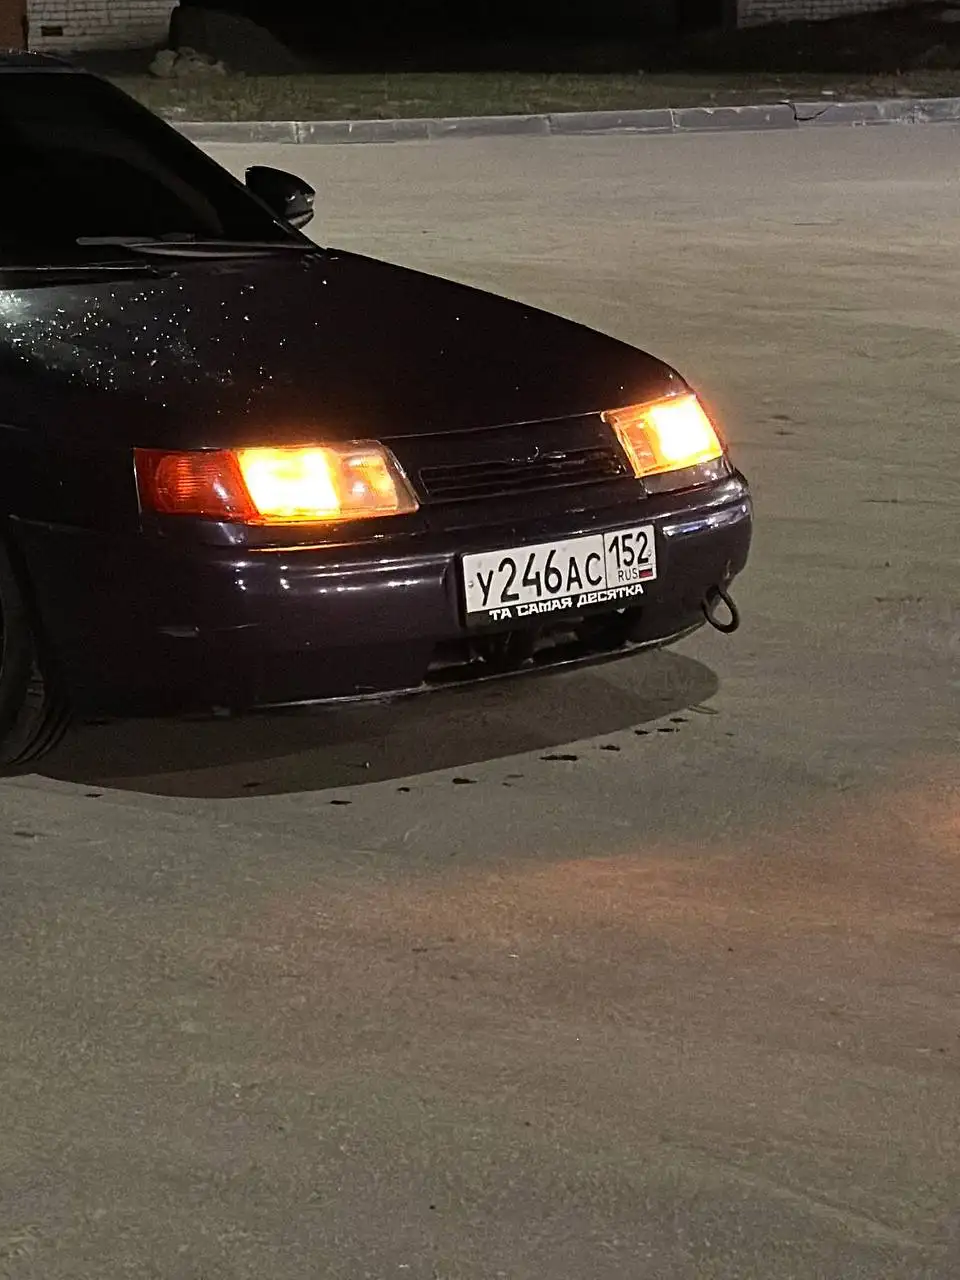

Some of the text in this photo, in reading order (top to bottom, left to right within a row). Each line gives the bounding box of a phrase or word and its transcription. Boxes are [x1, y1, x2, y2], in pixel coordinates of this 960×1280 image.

[476, 531, 650, 606] У246АС 152
[617, 567, 639, 582] RUS
[489, 584, 644, 621] ТА САМАЯ ДЕСЯТКА
